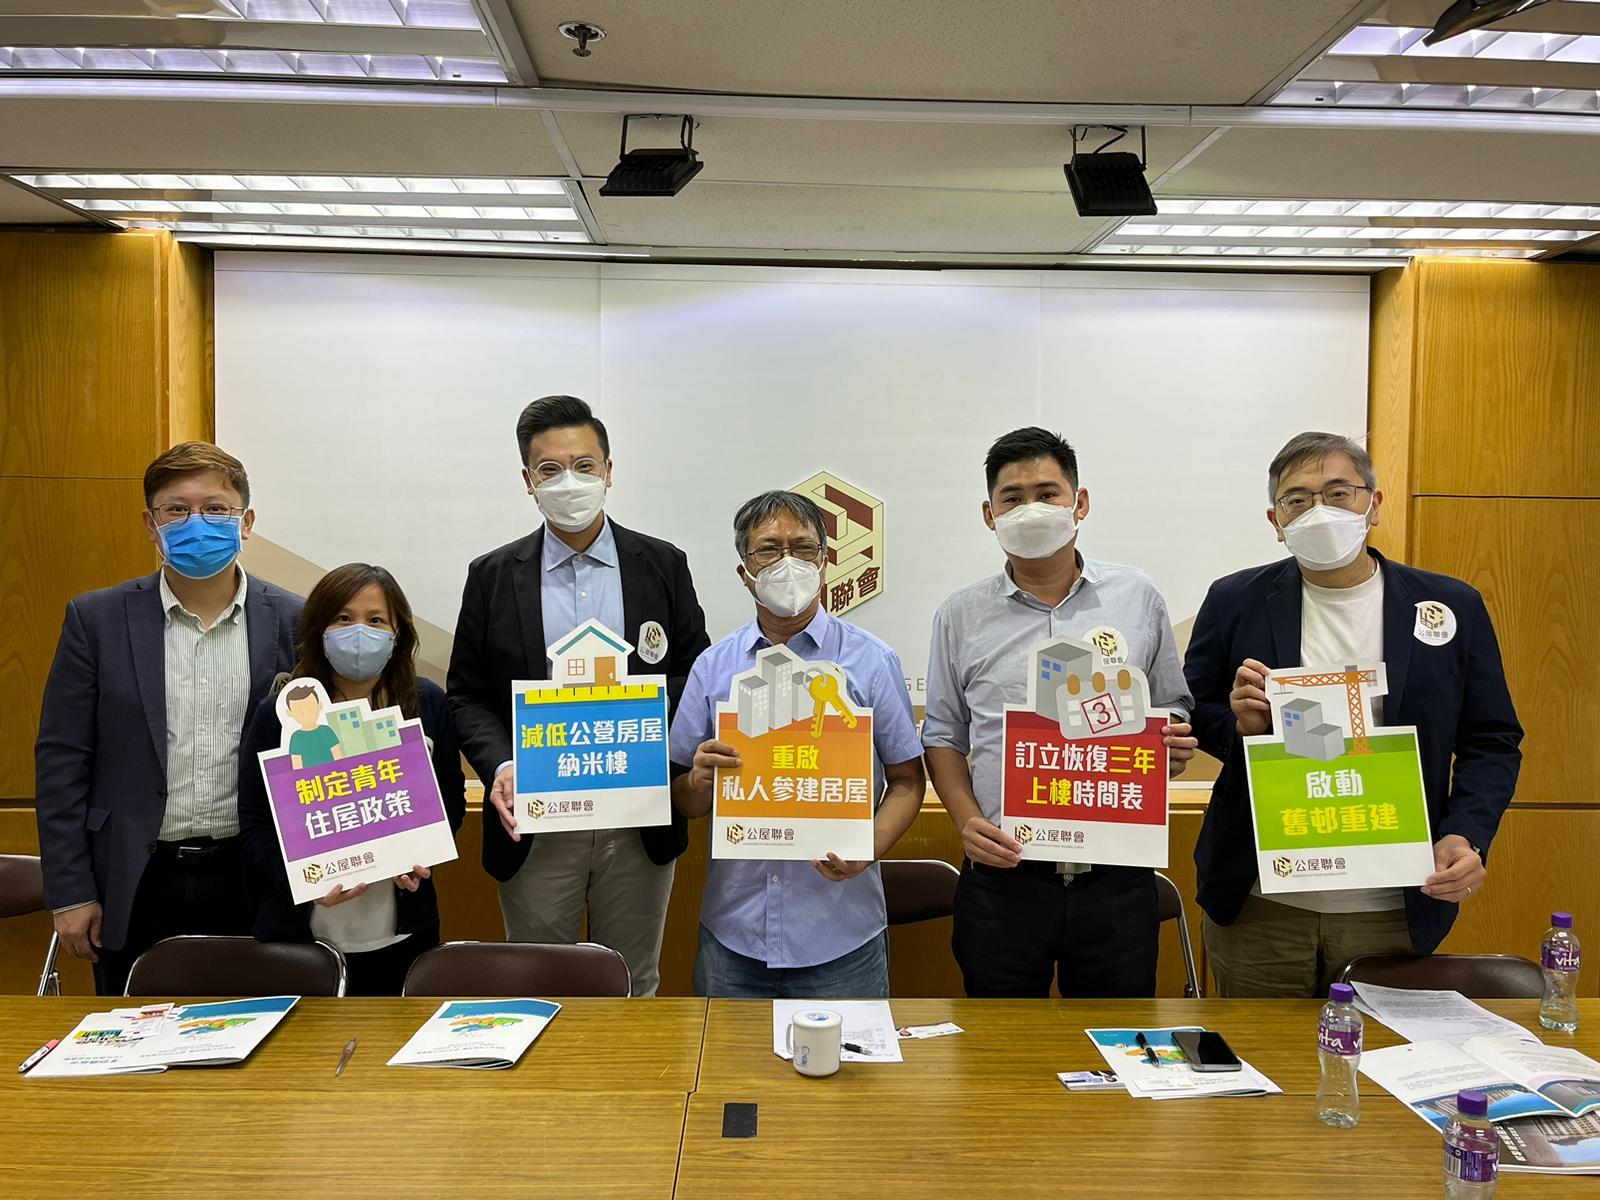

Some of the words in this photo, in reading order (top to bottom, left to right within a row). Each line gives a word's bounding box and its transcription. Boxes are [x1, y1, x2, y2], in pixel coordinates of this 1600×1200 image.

[1092, 702, 1112, 725] 3
[521, 718, 663, 748] 減低公營房屋
[557, 750, 629, 778] 納米樓
[772, 745, 820, 770] 重啟
[1015, 741, 1156, 775] 訂立恢復三年
[295, 758, 404, 805] 制定青年
[722, 775, 868, 803] 私人參建居屋
[1026, 776, 1144, 810] 上樓時間表
[1306, 768, 1364, 799] 啟動
[305, 789, 413, 840] 住屋政策
[547, 800, 594, 814] 公屋聯會
[1280, 802, 1399, 836] 舊邨重建
[747, 828, 795, 841] 公屋聯會
[1035, 829, 1085, 844] 公屋聯會
[325, 851, 375, 875] 公屋聯會
[1295, 857, 1346, 872] 公屋聯會
